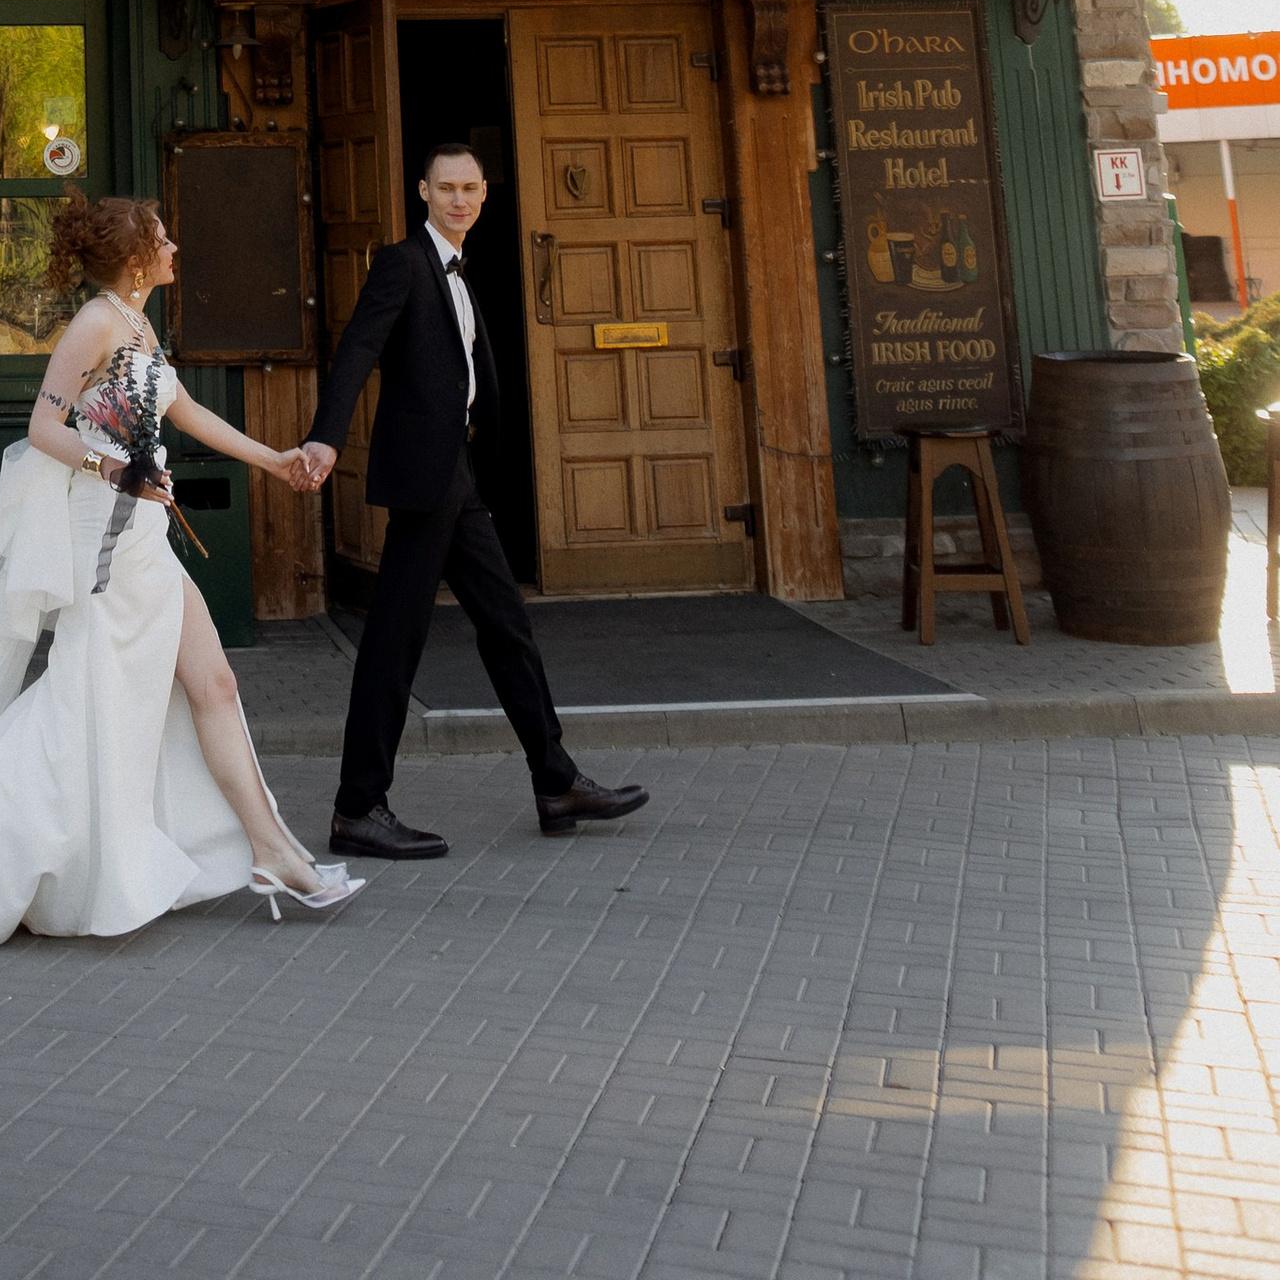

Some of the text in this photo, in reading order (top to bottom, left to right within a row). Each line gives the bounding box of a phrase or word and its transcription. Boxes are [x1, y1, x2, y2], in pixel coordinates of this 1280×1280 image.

[857, 78, 962, 111] Irish Pub
[847, 118, 979, 151] Restaurant
[884, 157, 949, 189] Hotel
[873, 306, 987, 336] Traditional
[872, 339, 997, 365] IRISH FOOD
[918, 378, 954, 394] agus
[958, 372, 994, 390] ceoil
[896, 398, 934, 415] agus
